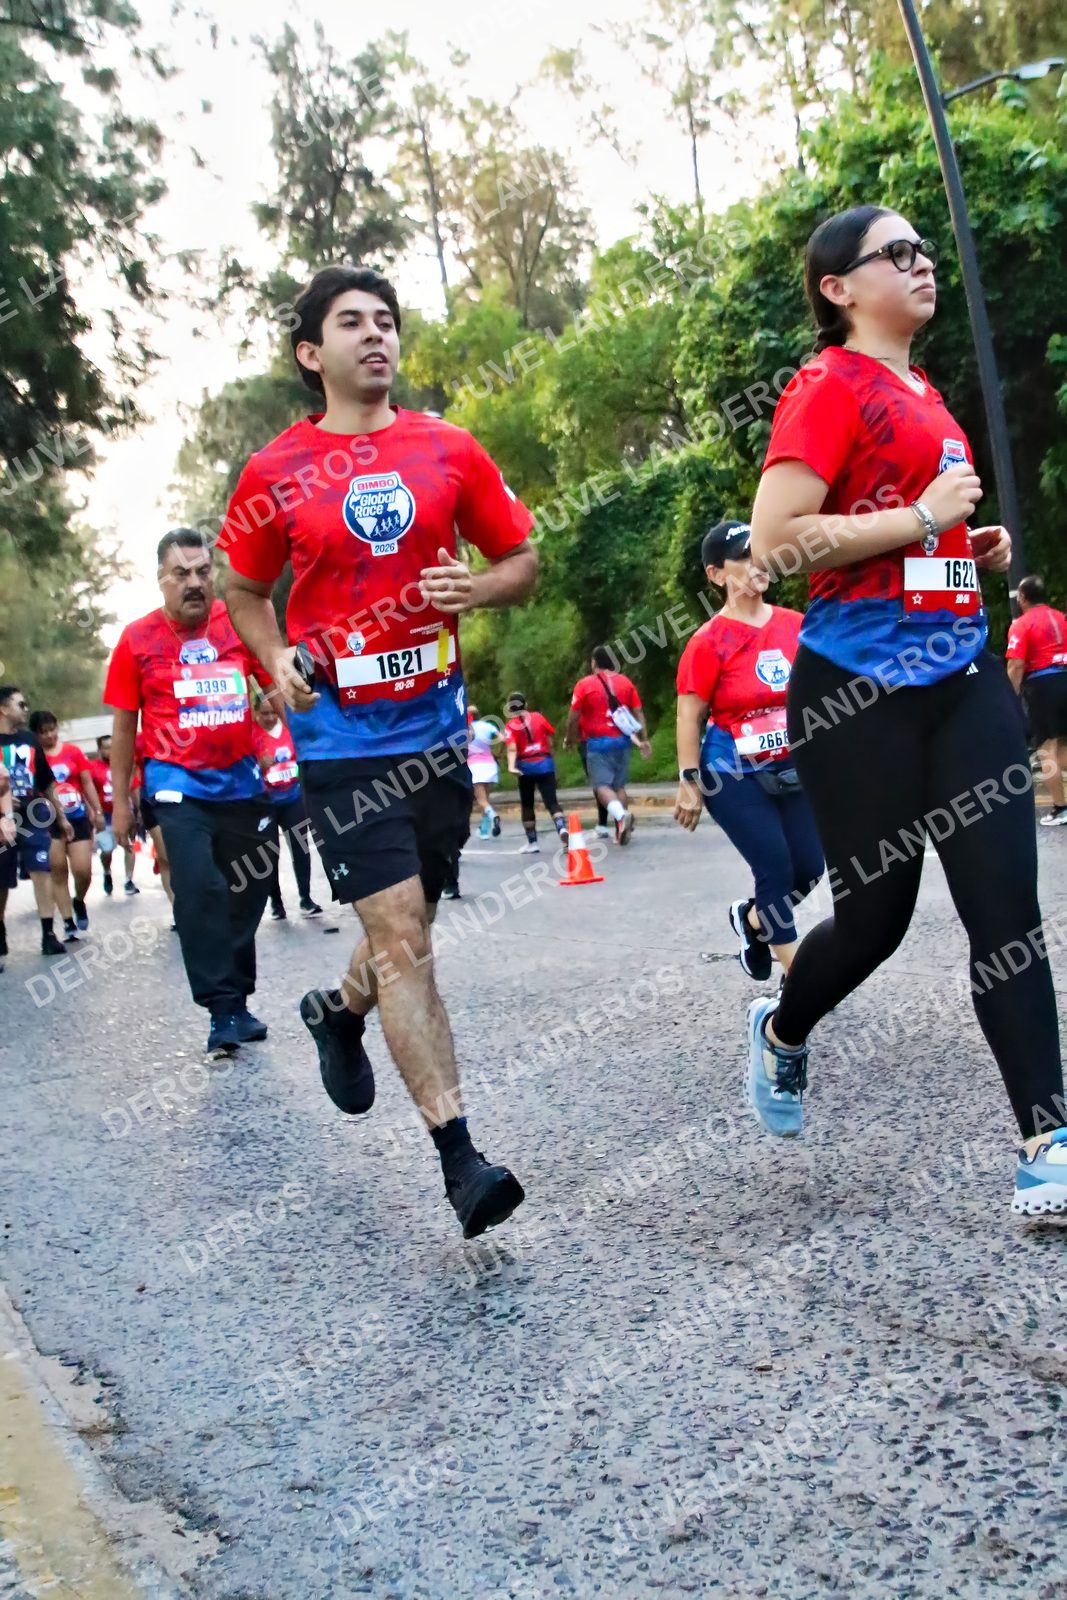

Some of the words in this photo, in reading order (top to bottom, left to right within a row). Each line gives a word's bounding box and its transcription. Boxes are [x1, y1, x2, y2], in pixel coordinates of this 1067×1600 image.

[357, 478, 395, 491] BIMBO
[360, 490, 396, 507] Global
[354, 504, 384, 518] Race
[374, 543, 395, 554] 2026
[945, 559, 975, 588] 1622
[376, 647, 423, 680] 1621
[196, 679, 228, 694] 3399
